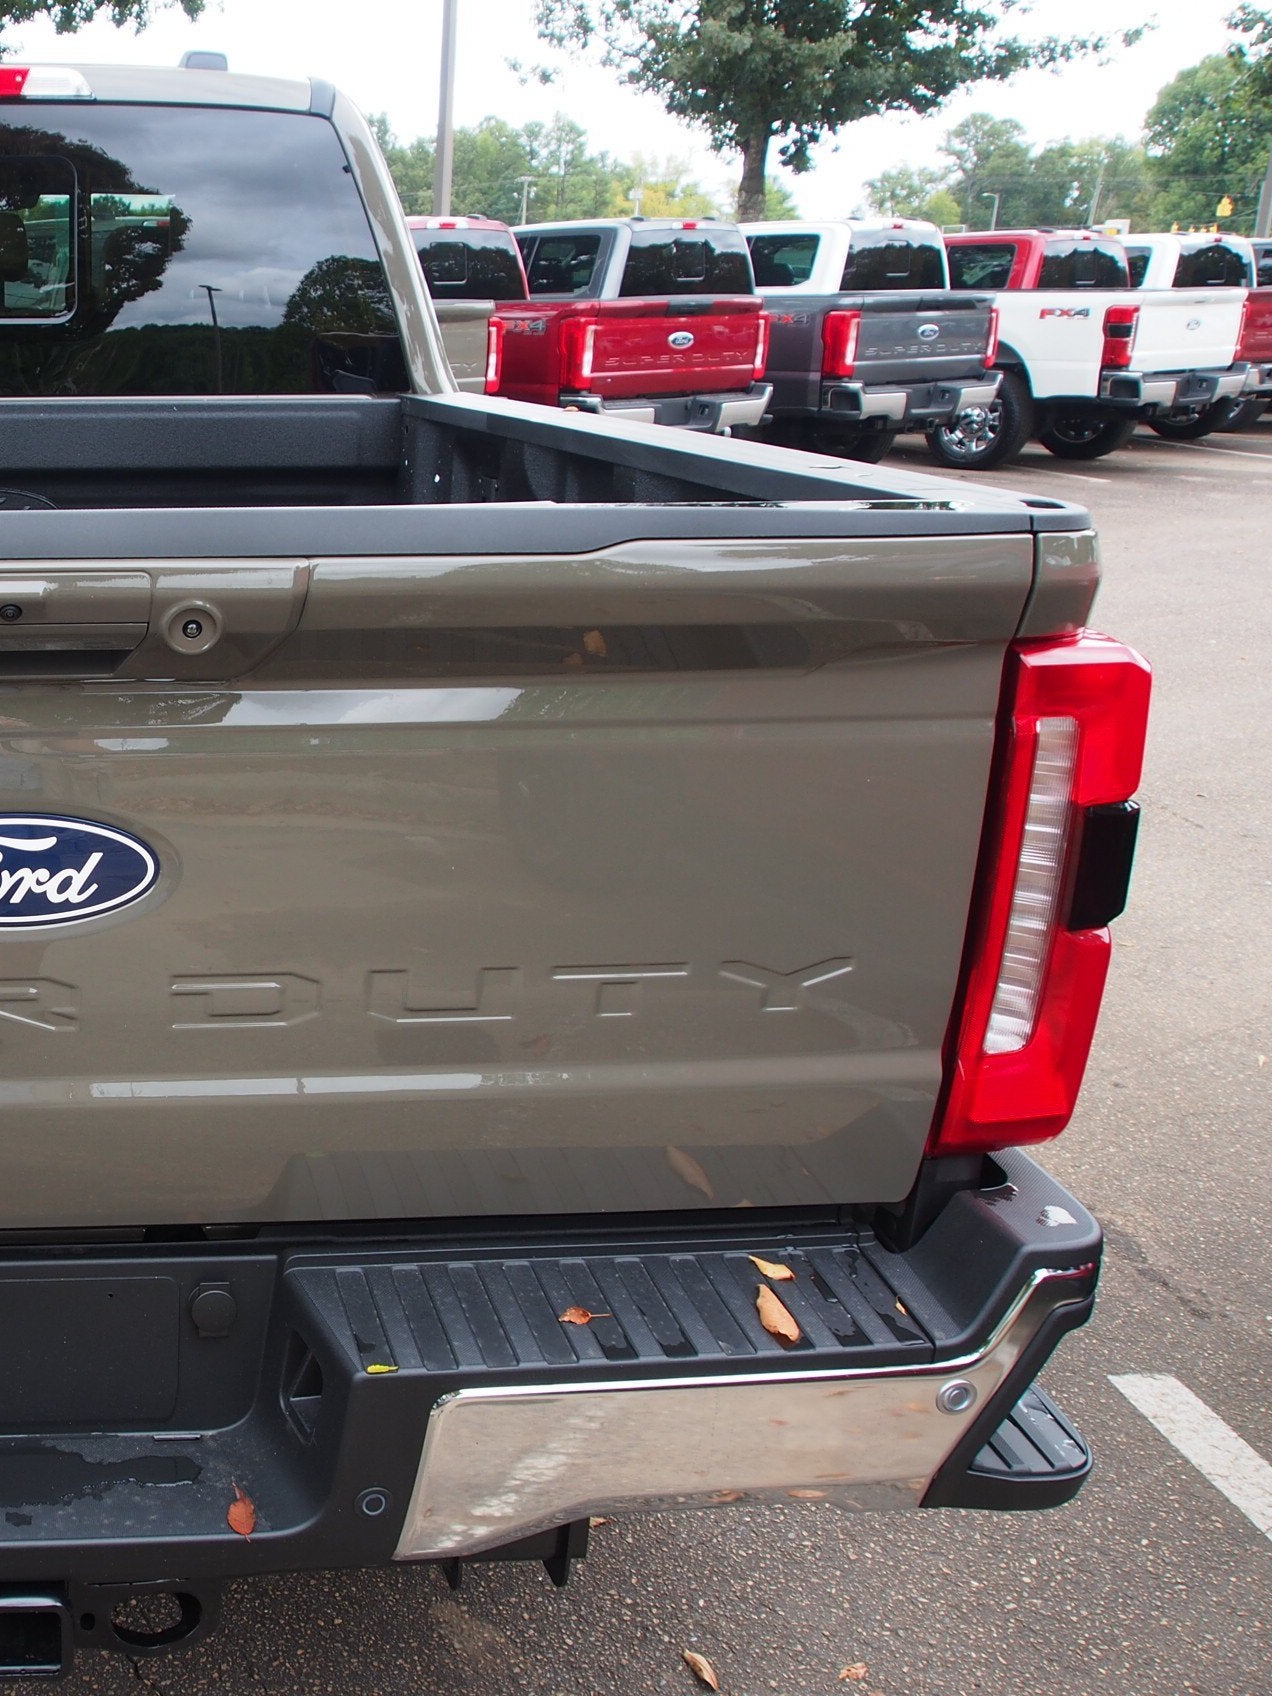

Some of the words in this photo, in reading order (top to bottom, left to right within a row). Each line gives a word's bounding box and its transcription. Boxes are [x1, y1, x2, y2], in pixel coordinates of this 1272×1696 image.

[1039, 308, 1090, 319] FX4
[865, 345, 930, 356] SUPER
[604, 354, 686, 366] SUPER
[691, 351, 748, 362] DUTY
[171, 956, 855, 1030] DUTY
